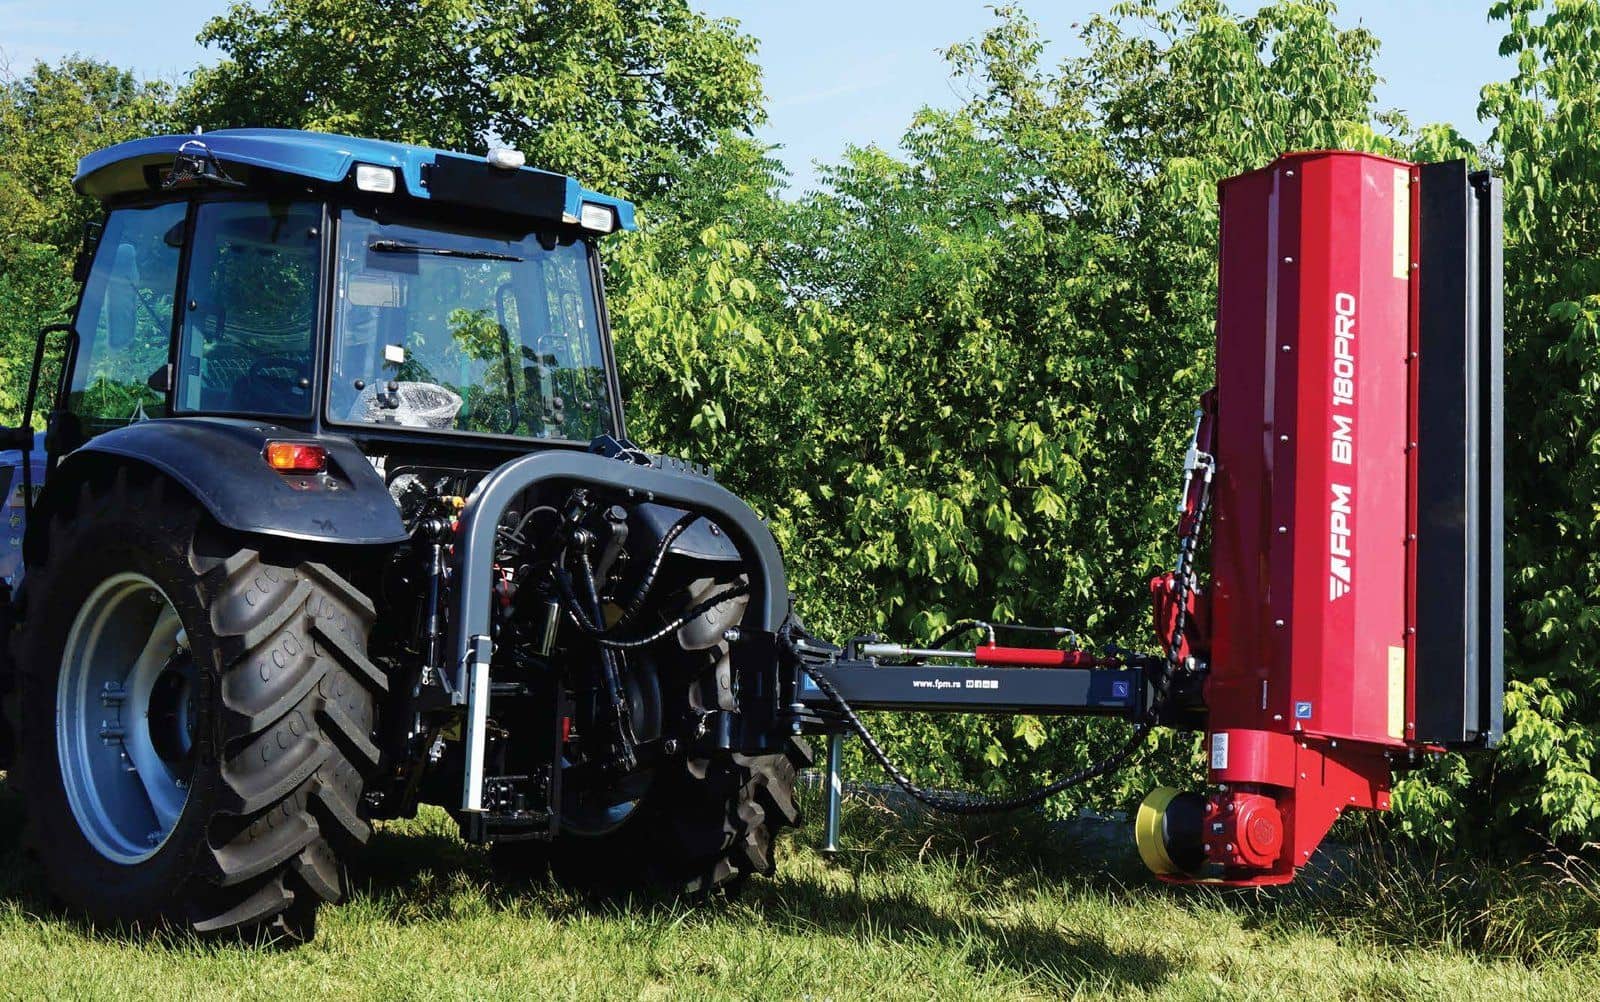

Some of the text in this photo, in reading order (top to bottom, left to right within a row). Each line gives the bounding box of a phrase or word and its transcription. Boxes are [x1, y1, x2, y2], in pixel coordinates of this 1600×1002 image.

[1333, 292, 1356, 406] 180PRO
[1331, 415, 1353, 464] BM
[913, 679, 961, 690] www.fpm.rs
